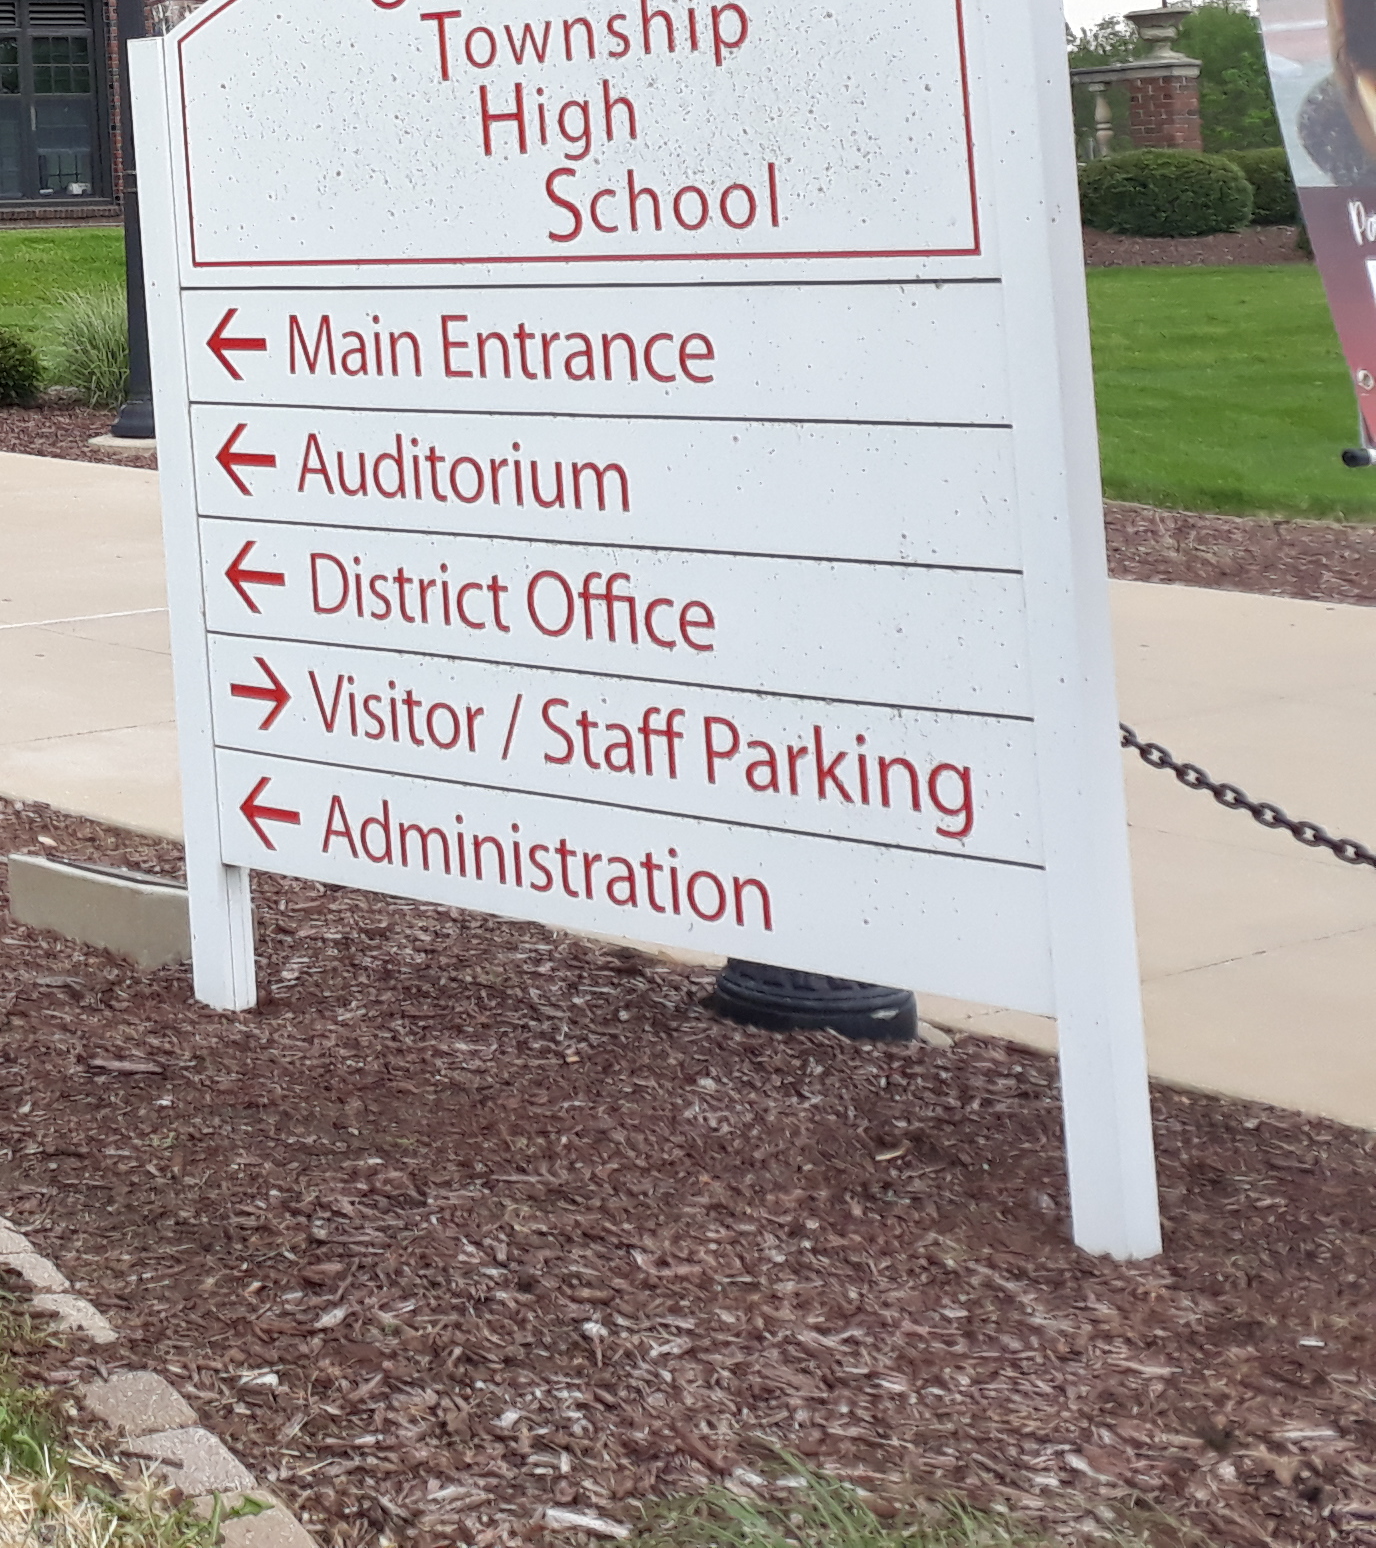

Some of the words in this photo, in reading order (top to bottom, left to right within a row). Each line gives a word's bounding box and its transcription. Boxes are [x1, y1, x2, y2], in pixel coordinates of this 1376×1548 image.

[478, 79, 638, 162] High
[544, 161, 780, 243] School
[288, 314, 422, 378] Main
[440, 314, 715, 384] Entrance
[298, 433, 630, 512] Auditorium
[310, 552, 510, 632] District
[526, 569, 716, 652] Office
[308, 671, 484, 750] Visitor
[500, 692, 524, 762] /
[542, 698, 686, 779] Staff
[704, 716, 975, 839] Parking
[322, 795, 773, 931] Administration
